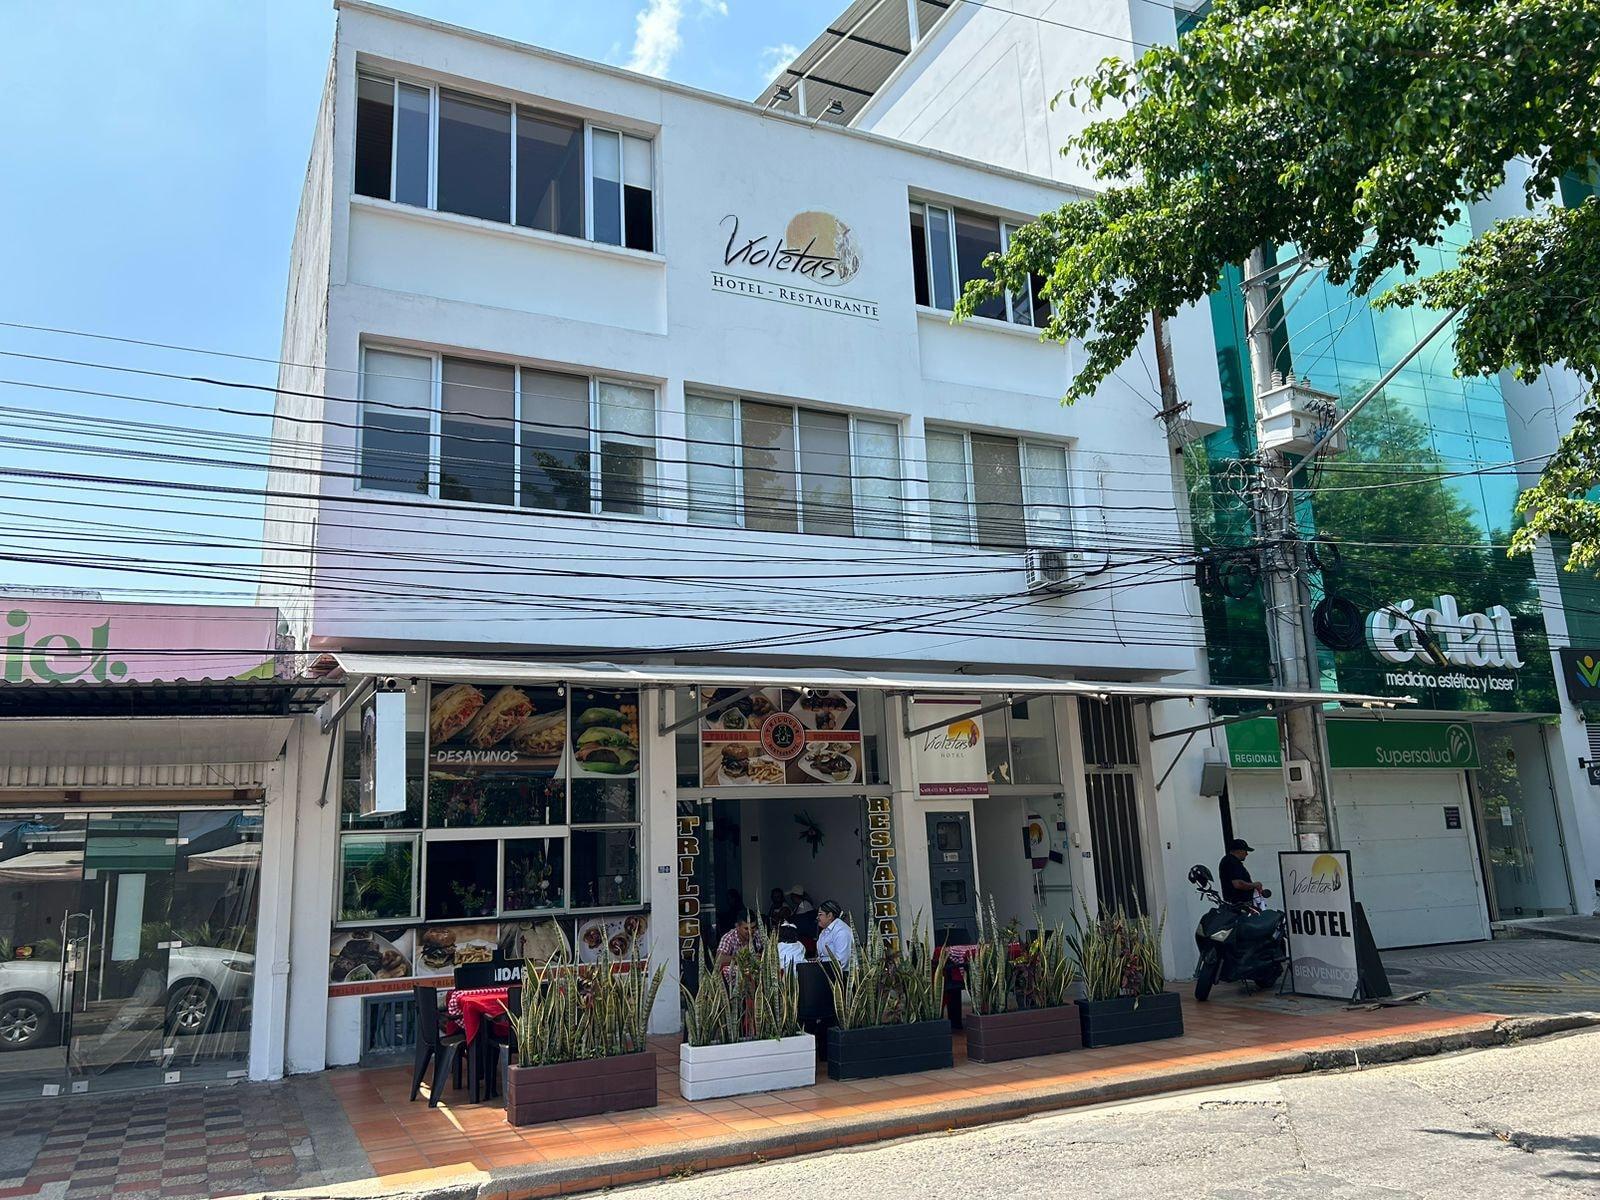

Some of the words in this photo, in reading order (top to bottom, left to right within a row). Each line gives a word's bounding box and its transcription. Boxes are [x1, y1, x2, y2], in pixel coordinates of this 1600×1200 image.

[719, 214, 840, 278] Violetas
[713, 275, 764, 294] HOTEL
[779, 288, 878, 316] RESTAURANTE
[1386, 671, 1436, 688] medicina
[1438, 673, 1479, 689] estética
[1480, 677, 1487, 692] y
[1488, 675, 1514, 690] laser
[923, 730, 969, 752] Violetas
[1235, 753, 1278, 764] REGIONAL
[1375, 746, 1451, 765] Supersalud
[677, 815, 700, 962] TRILOGÍ
[1289, 869, 1333, 896] Violetas
[1289, 909, 1351, 937] HOTEL
[494, 965, 529, 982] IDA
[1294, 963, 1357, 981] BIENVENIDOS
